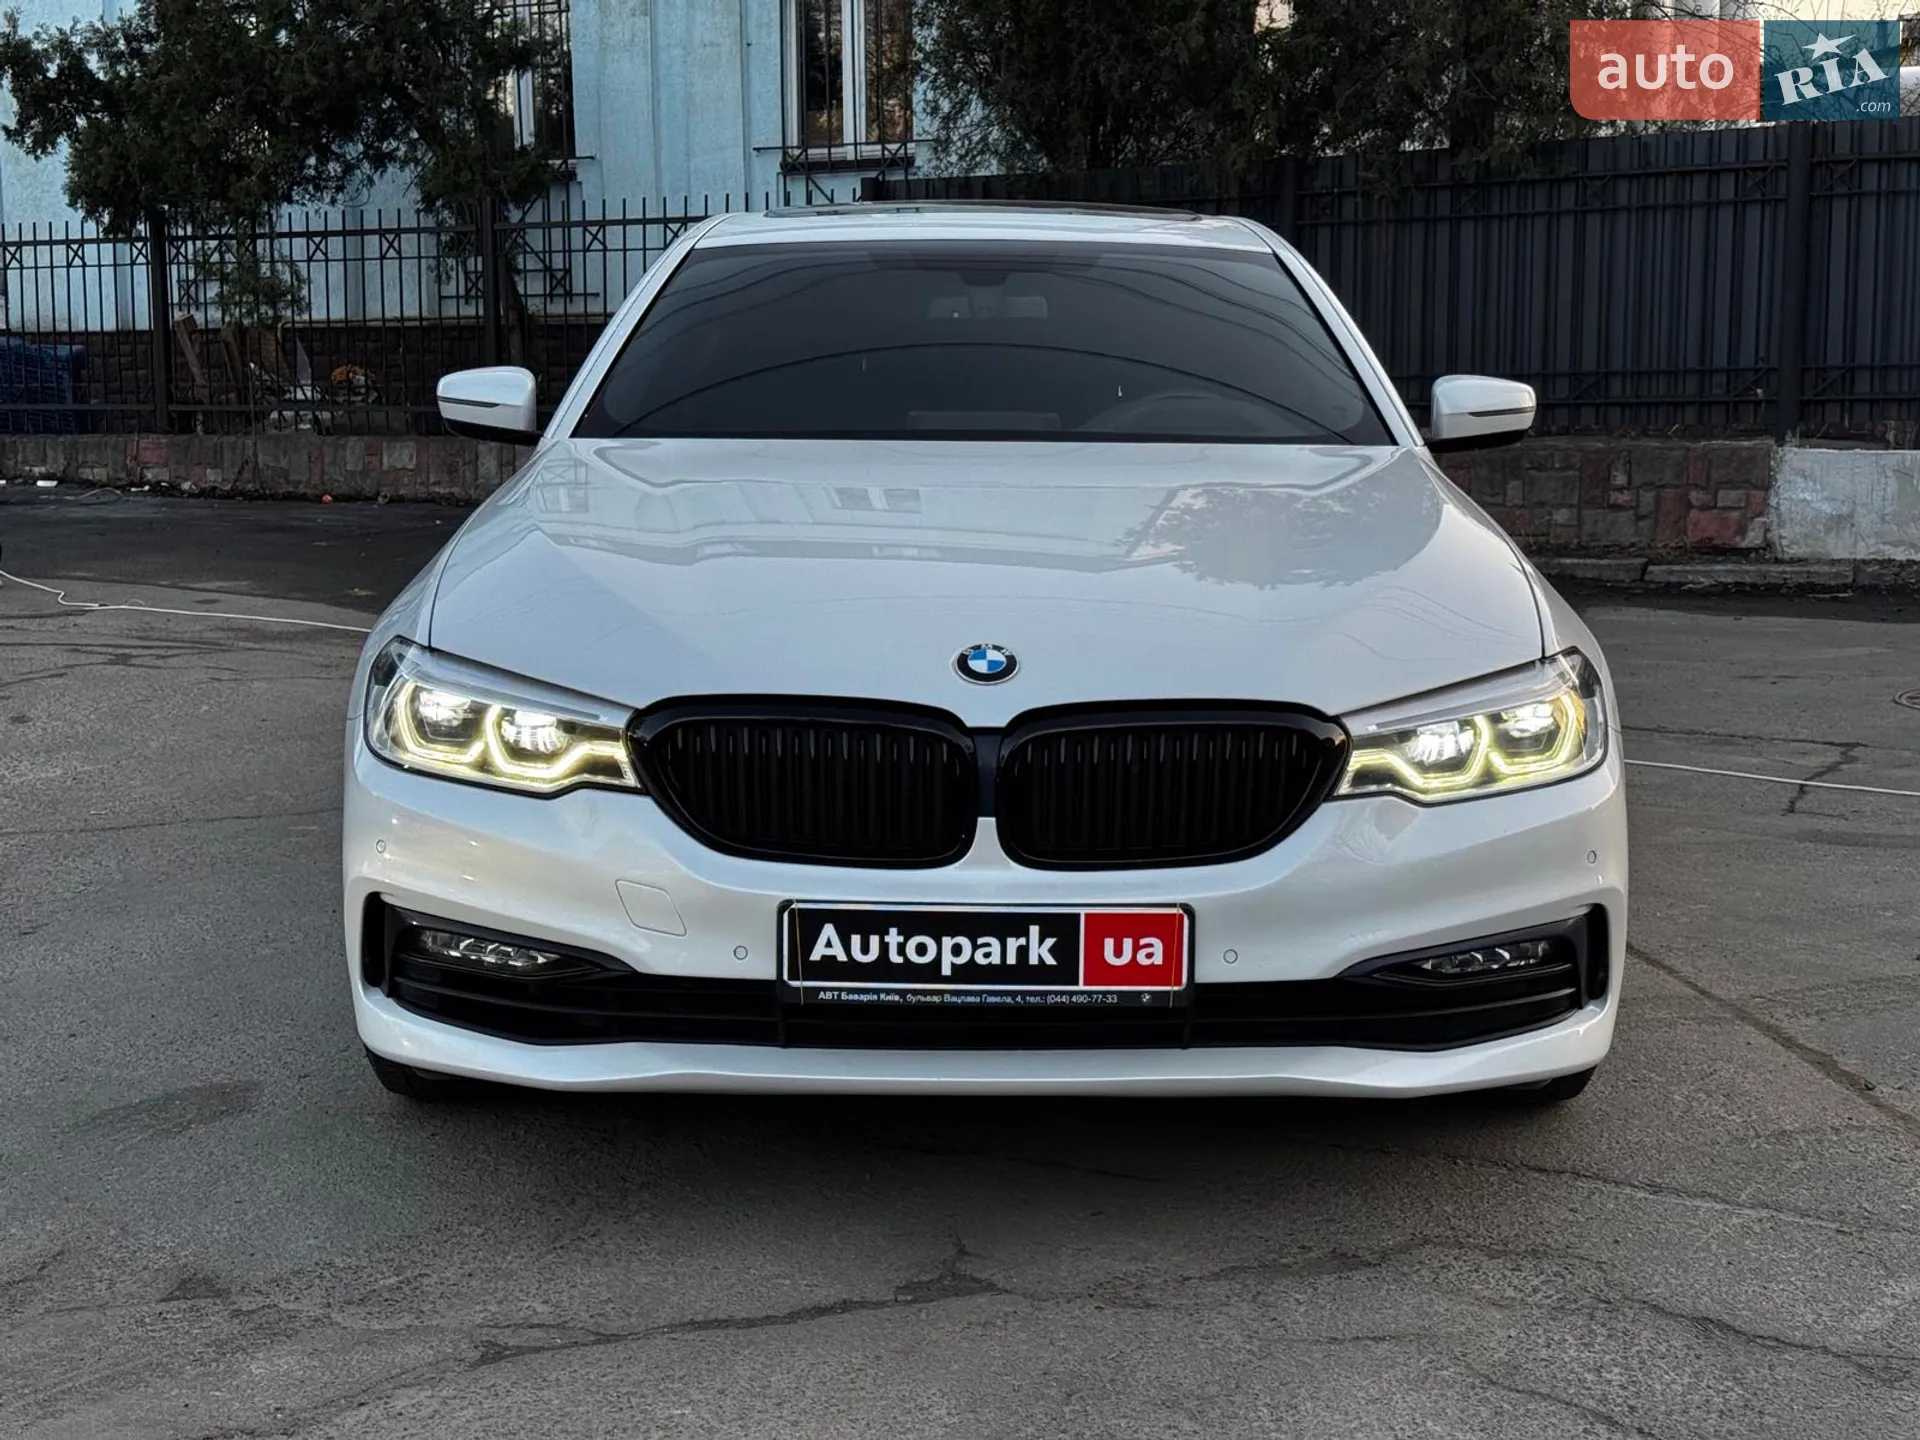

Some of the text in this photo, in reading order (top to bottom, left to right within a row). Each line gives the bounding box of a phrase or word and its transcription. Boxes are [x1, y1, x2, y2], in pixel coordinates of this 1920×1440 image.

[809, 923, 1163, 976] Autopark ua
[906, 993, 942, 1004] бульвар
[1047, 994, 1069, 1004] (044)
[1071, 994, 1117, 1004] 490-77-33
